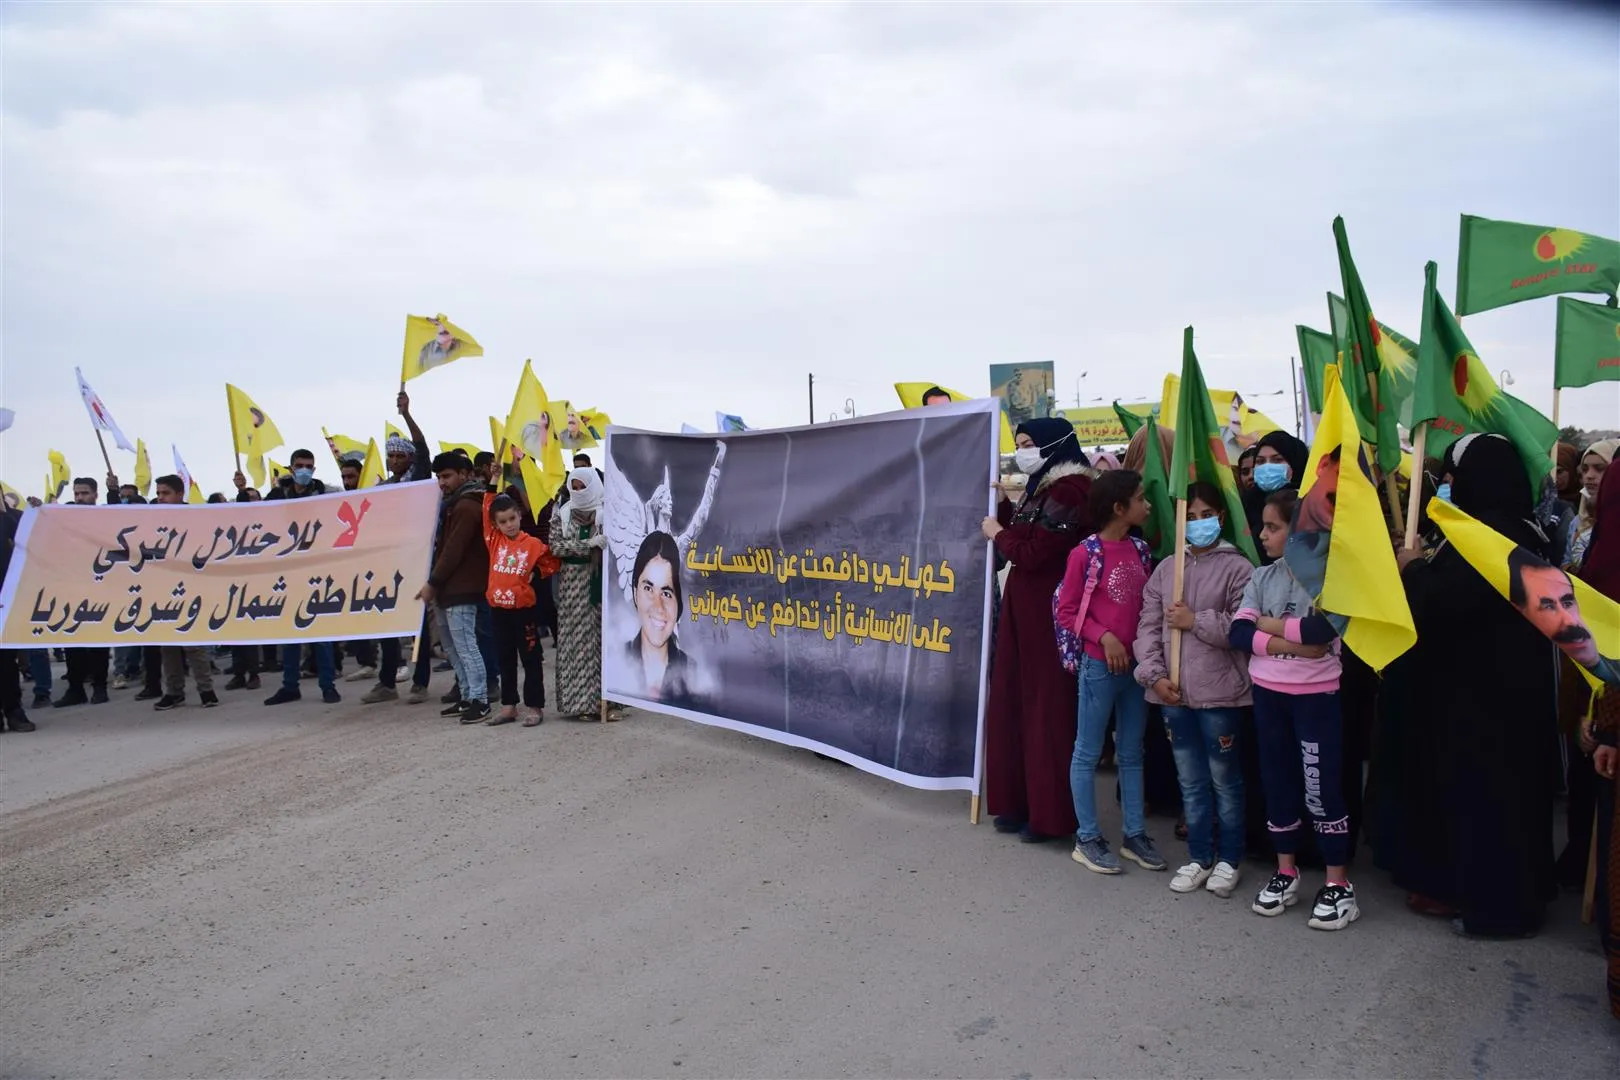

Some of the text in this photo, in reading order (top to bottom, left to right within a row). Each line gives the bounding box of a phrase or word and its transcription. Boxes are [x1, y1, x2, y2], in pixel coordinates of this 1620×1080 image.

[92, 497, 372, 582] لا للاحتلال التركي
[686, 541, 955, 599] كوباني دافعت عن الانسانية
[30, 569, 405, 637] لمناطق شمال وشرق سوريا
[689, 590, 952, 653] على الانسانية أن تدافع عن كوباني
[1300, 740, 1326, 817] FASHION
